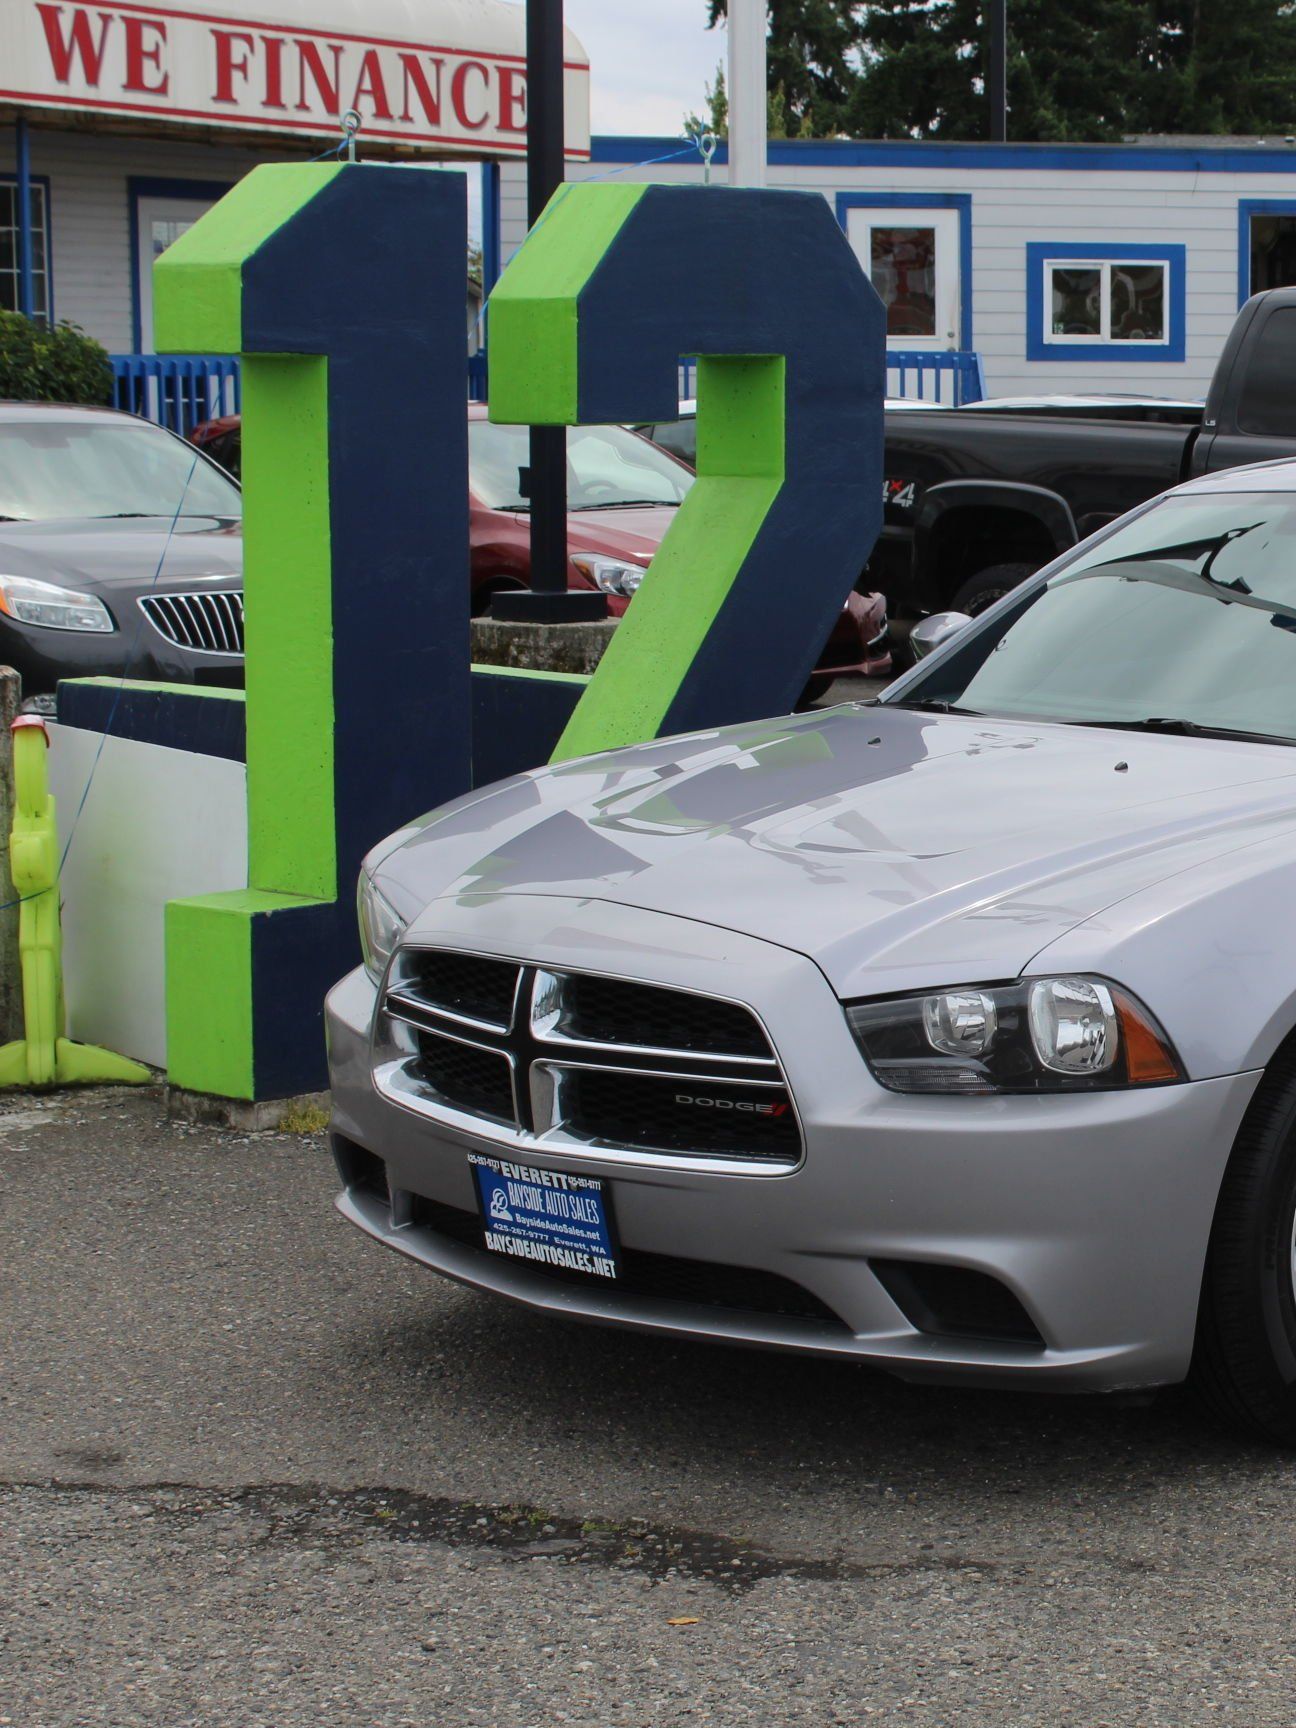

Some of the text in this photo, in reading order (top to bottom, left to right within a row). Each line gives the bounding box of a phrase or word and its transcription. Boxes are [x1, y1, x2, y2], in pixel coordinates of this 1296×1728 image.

[35, 3, 527, 133] WE FINANCE
[675, 1094, 774, 1113] DODGE
[500, 1161, 569, 1190] EVERETT
[507, 1182, 600, 1225] BAYSIDE AUTO SALES
[493, 1222, 607, 1255] 425-267-9777 Everett, WA
[515, 1214, 601, 1241] BaysideAutoSales.net
[484, 1231, 616, 1279] BAYSIDEAUTOSALES.NET
